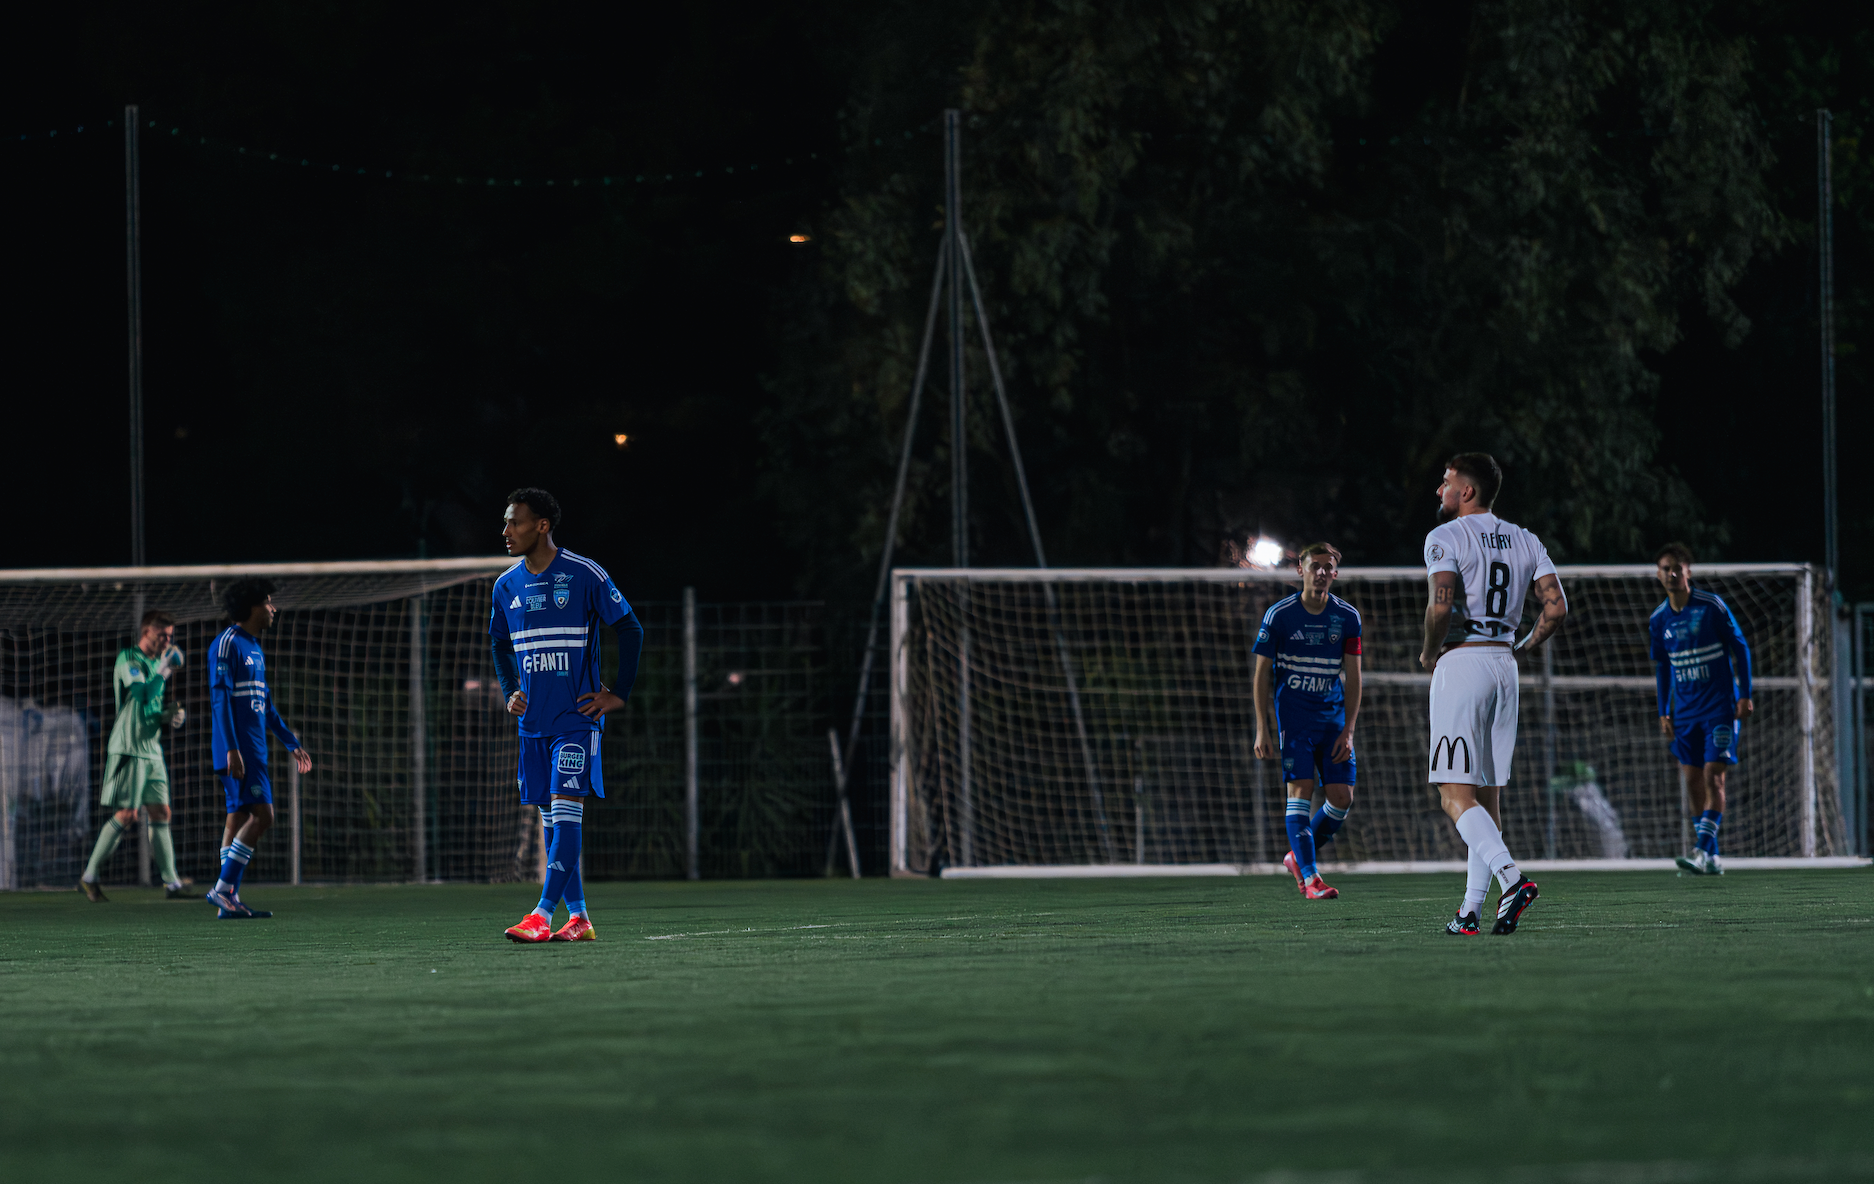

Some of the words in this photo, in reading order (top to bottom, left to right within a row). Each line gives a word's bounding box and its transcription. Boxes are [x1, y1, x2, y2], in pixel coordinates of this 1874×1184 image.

[1486, 561, 1510, 617] 8
[560, 752, 584, 760] BURGER
[559, 759, 584, 768] KING
